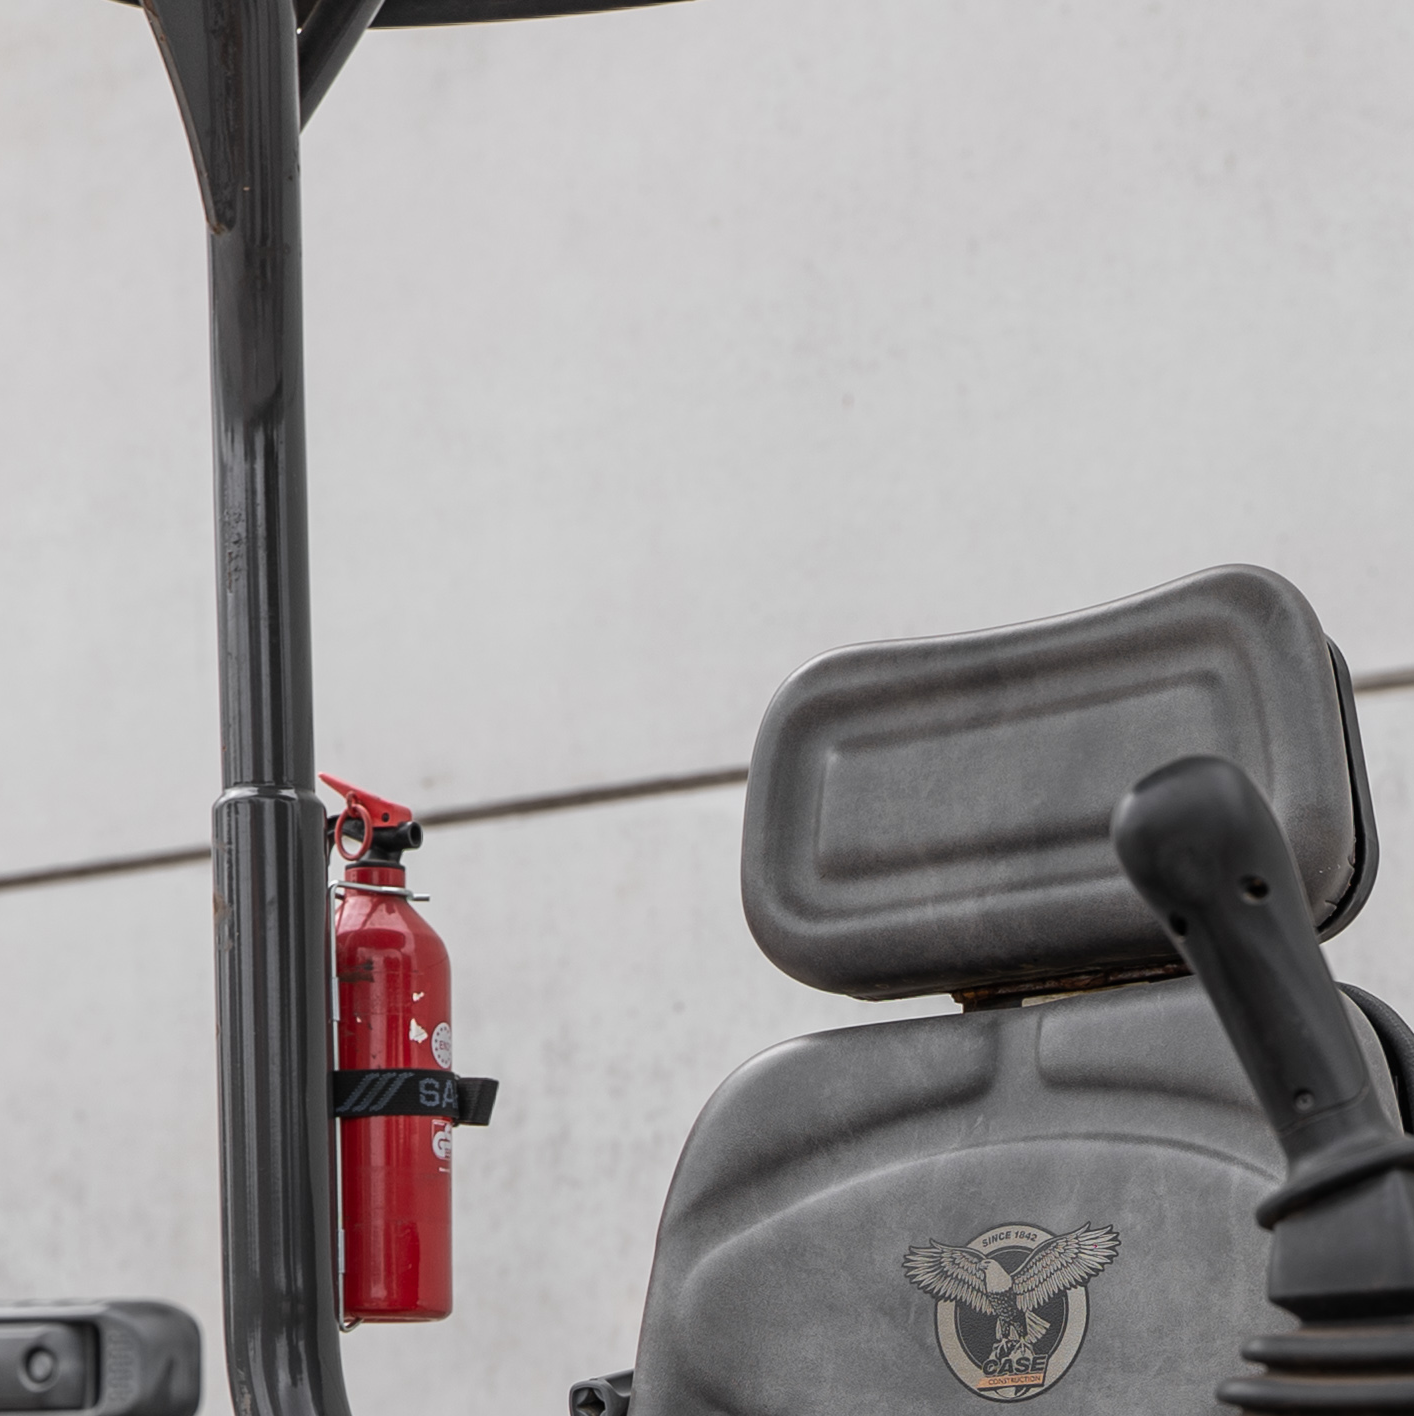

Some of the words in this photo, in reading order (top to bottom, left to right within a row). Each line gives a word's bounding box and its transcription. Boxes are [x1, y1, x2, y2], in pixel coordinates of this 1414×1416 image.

[419, 1078, 458, 1109] SA
[982, 1231, 1012, 1247] SINCE
[1015, 1231, 1038, 1242] 1842
[982, 1355, 1047, 1375] CASE
[988, 1376, 1041, 1385] CONSTRUCTION
